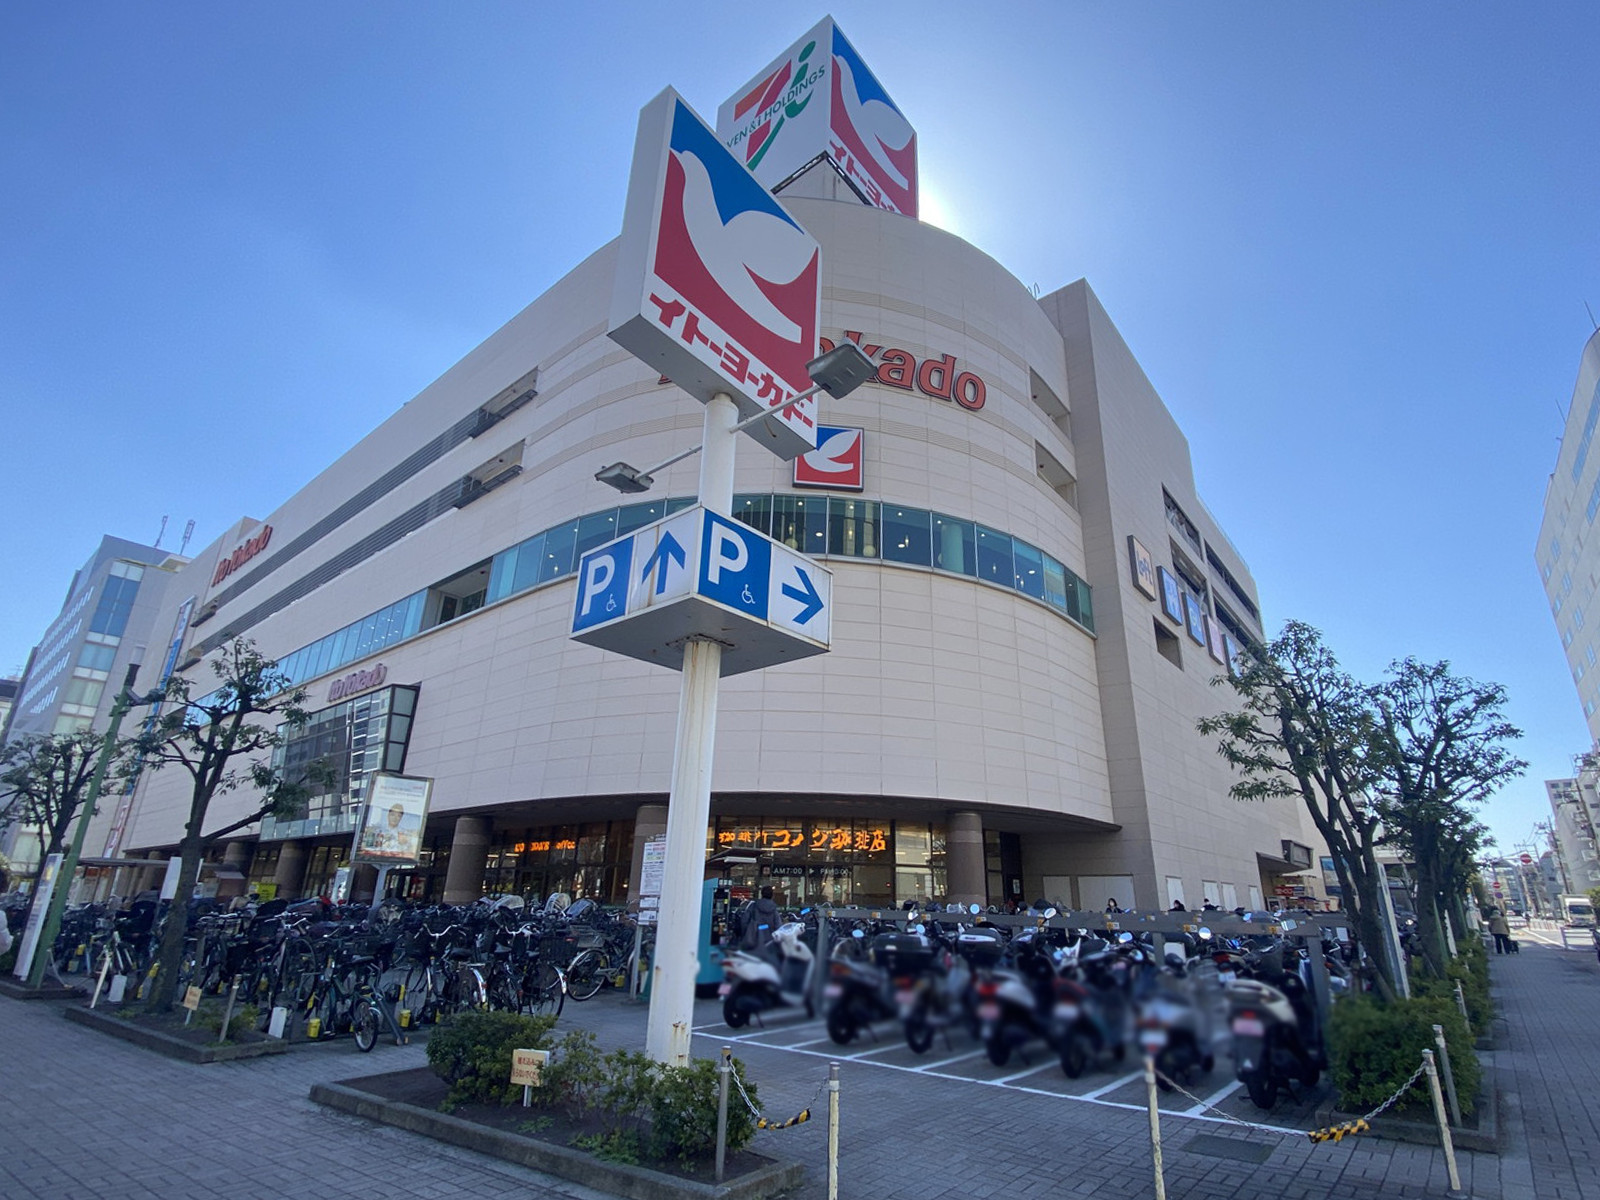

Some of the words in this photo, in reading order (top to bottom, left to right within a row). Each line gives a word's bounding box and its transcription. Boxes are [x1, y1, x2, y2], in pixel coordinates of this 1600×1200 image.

[764, 65, 826, 121] HOLDINGS
[649, 292, 814, 429] イトーヨーカドー
[707, 520, 749, 585] P
[581, 554, 615, 616] P
